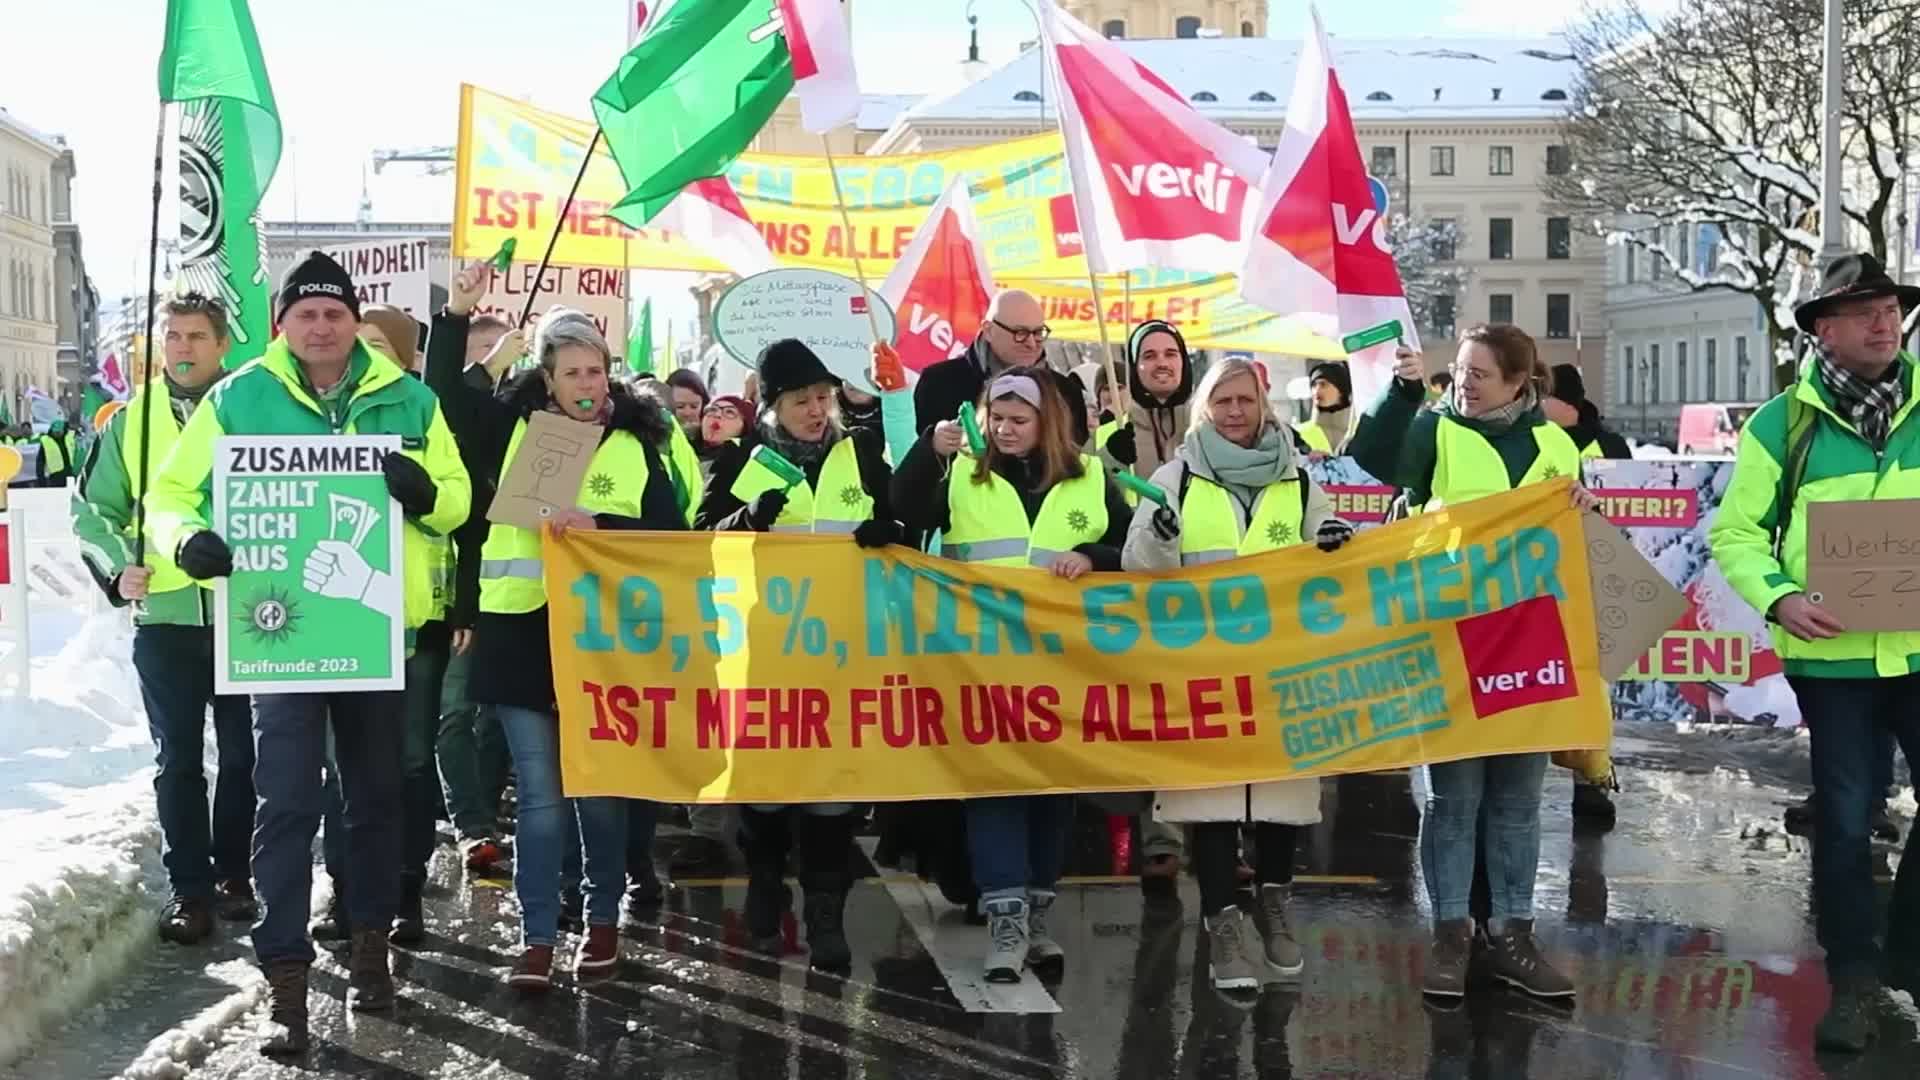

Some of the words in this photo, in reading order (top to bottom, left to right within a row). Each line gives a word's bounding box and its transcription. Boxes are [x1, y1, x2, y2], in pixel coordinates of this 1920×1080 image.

[473, 187, 544, 230] IST
[299, 283, 343, 296] POLIZEI
[489, 264, 572, 295] FLEGT
[229, 447, 391, 473] ZUSAMMEN
[230, 481, 319, 508] ZAHLT
[230, 513, 297, 540] SICH
[233, 545, 289, 571] AUS
[570, 571, 744, 672] 10,5
[863, 557, 1064, 656] MIN.
[1081, 574, 1272, 654] 500
[1297, 577, 1347, 635] €
[1367, 526, 1567, 627] MEHR
[233, 658, 315, 674] Tarifrunde
[320, 658, 359, 673] 2023
[1271, 645, 1441, 718] ZUSAMMEN
[582, 680, 676, 748] IST
[696, 687, 832, 749] MEHR
[850, 674, 949, 749] FÜR
[961, 683, 1064, 745] UNS
[1082, 675, 1257, 743] ALLE!
[1281, 709, 1361, 759] GEHT
[1372, 685, 1449, 735] MEHR
